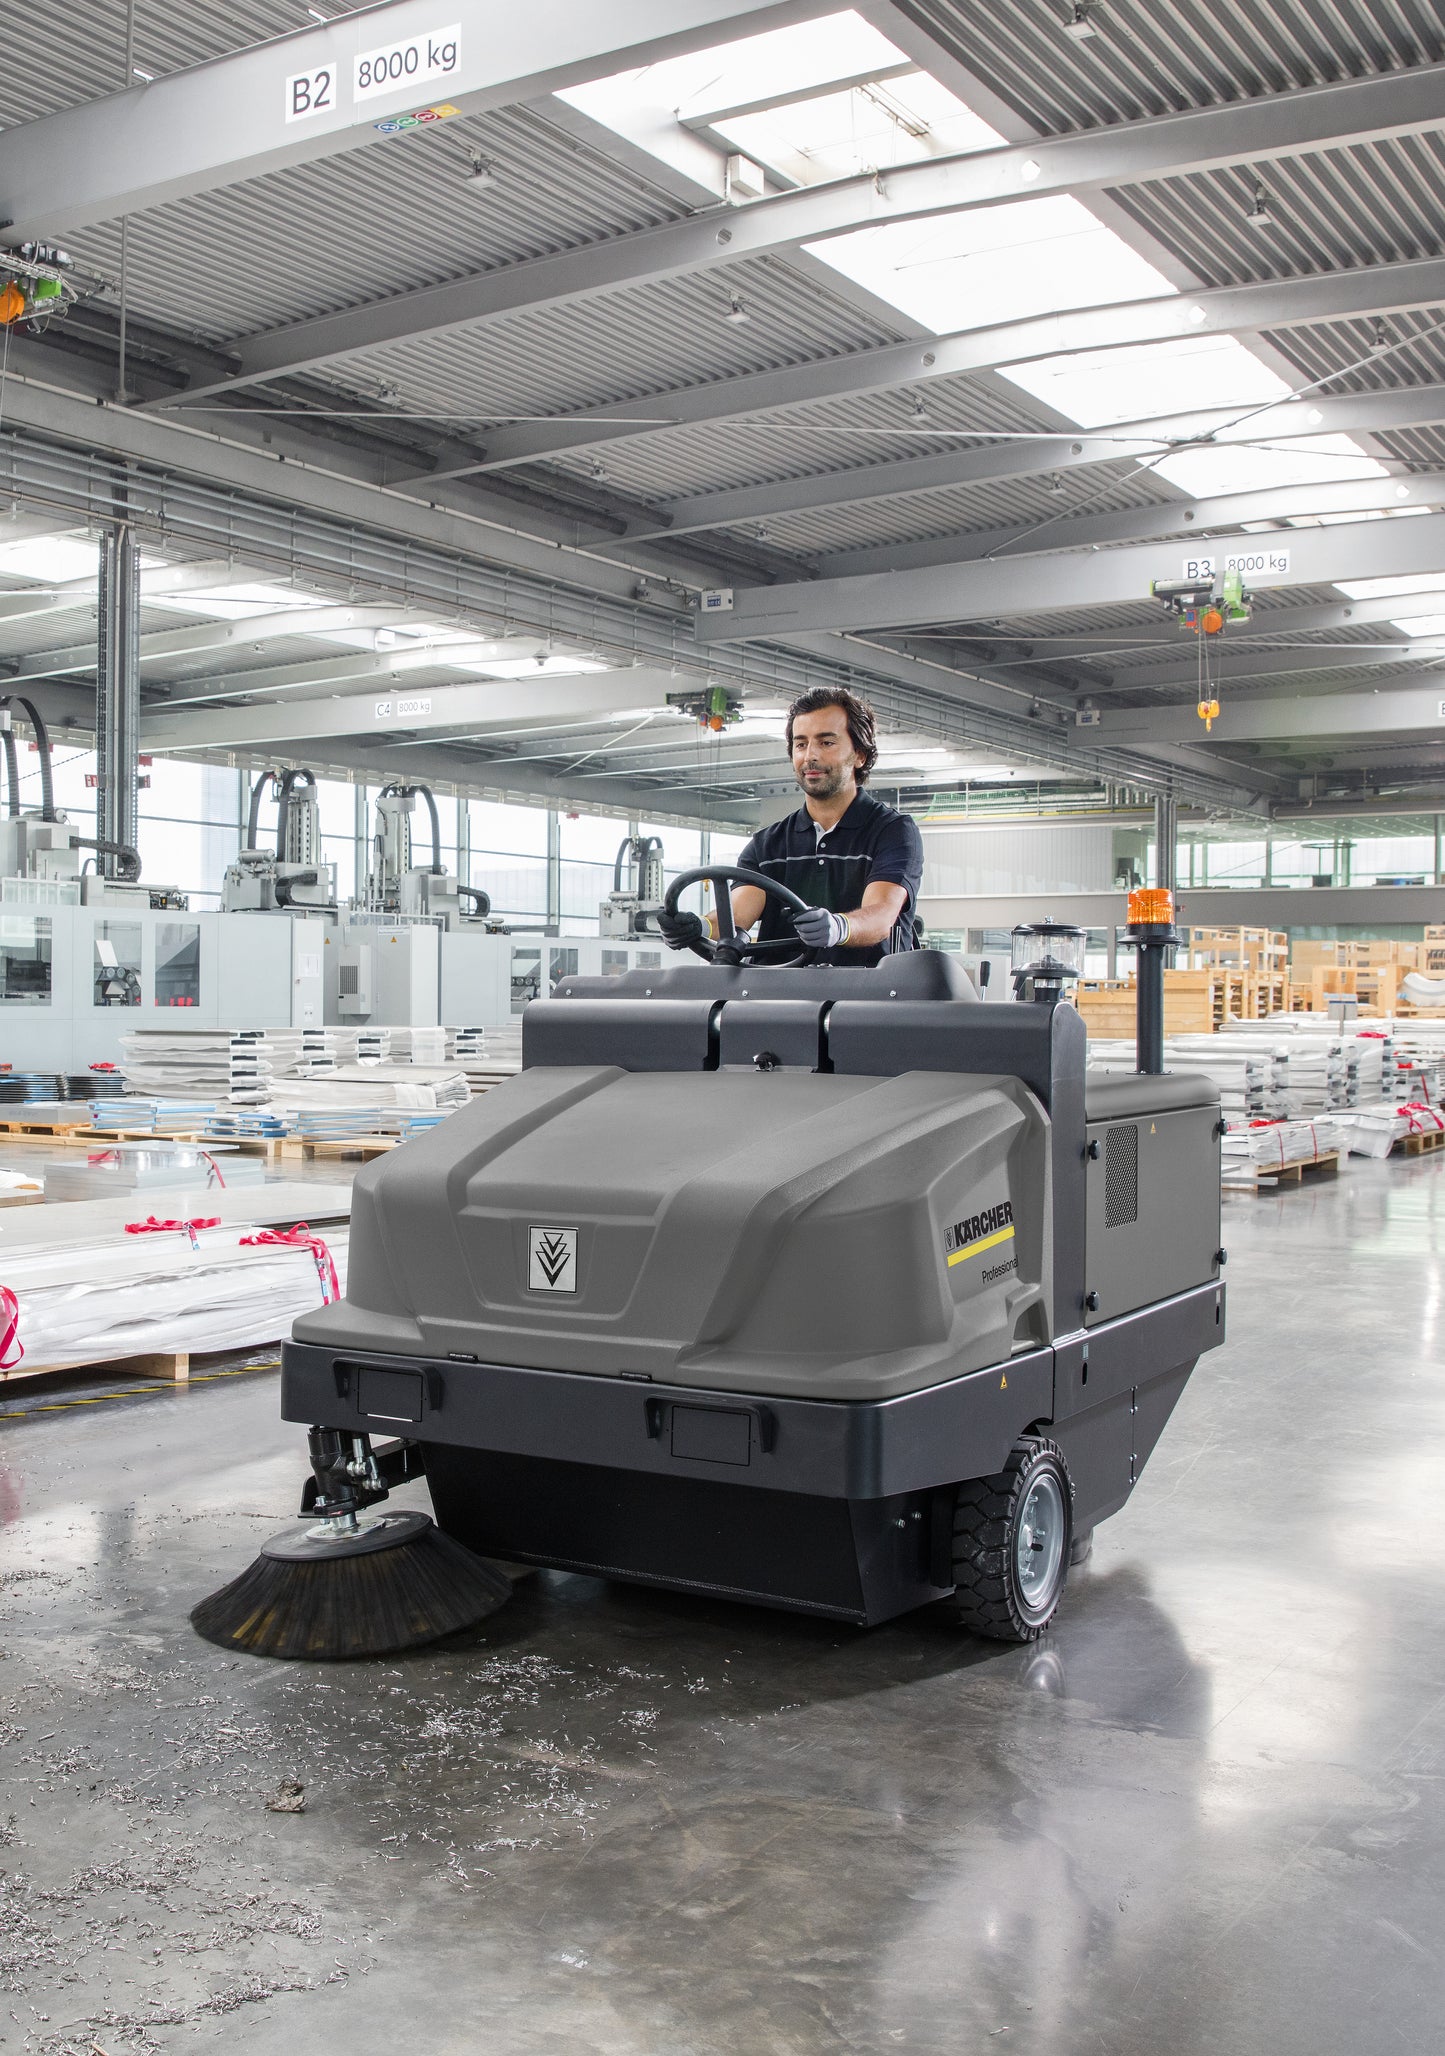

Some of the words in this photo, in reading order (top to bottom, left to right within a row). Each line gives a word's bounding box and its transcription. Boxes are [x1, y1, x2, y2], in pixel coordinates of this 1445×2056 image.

[358, 46, 418, 88] 8000
[428, 39, 456, 72] kg
[293, 71, 330, 115] B2
[1187, 560, 1211, 579] B3
[1269, 554, 1287, 571] kg
[377, 703, 390, 716] C4
[953, 1201, 1014, 1247] KÄRCHER
[981, 1254, 1019, 1284] Professional
